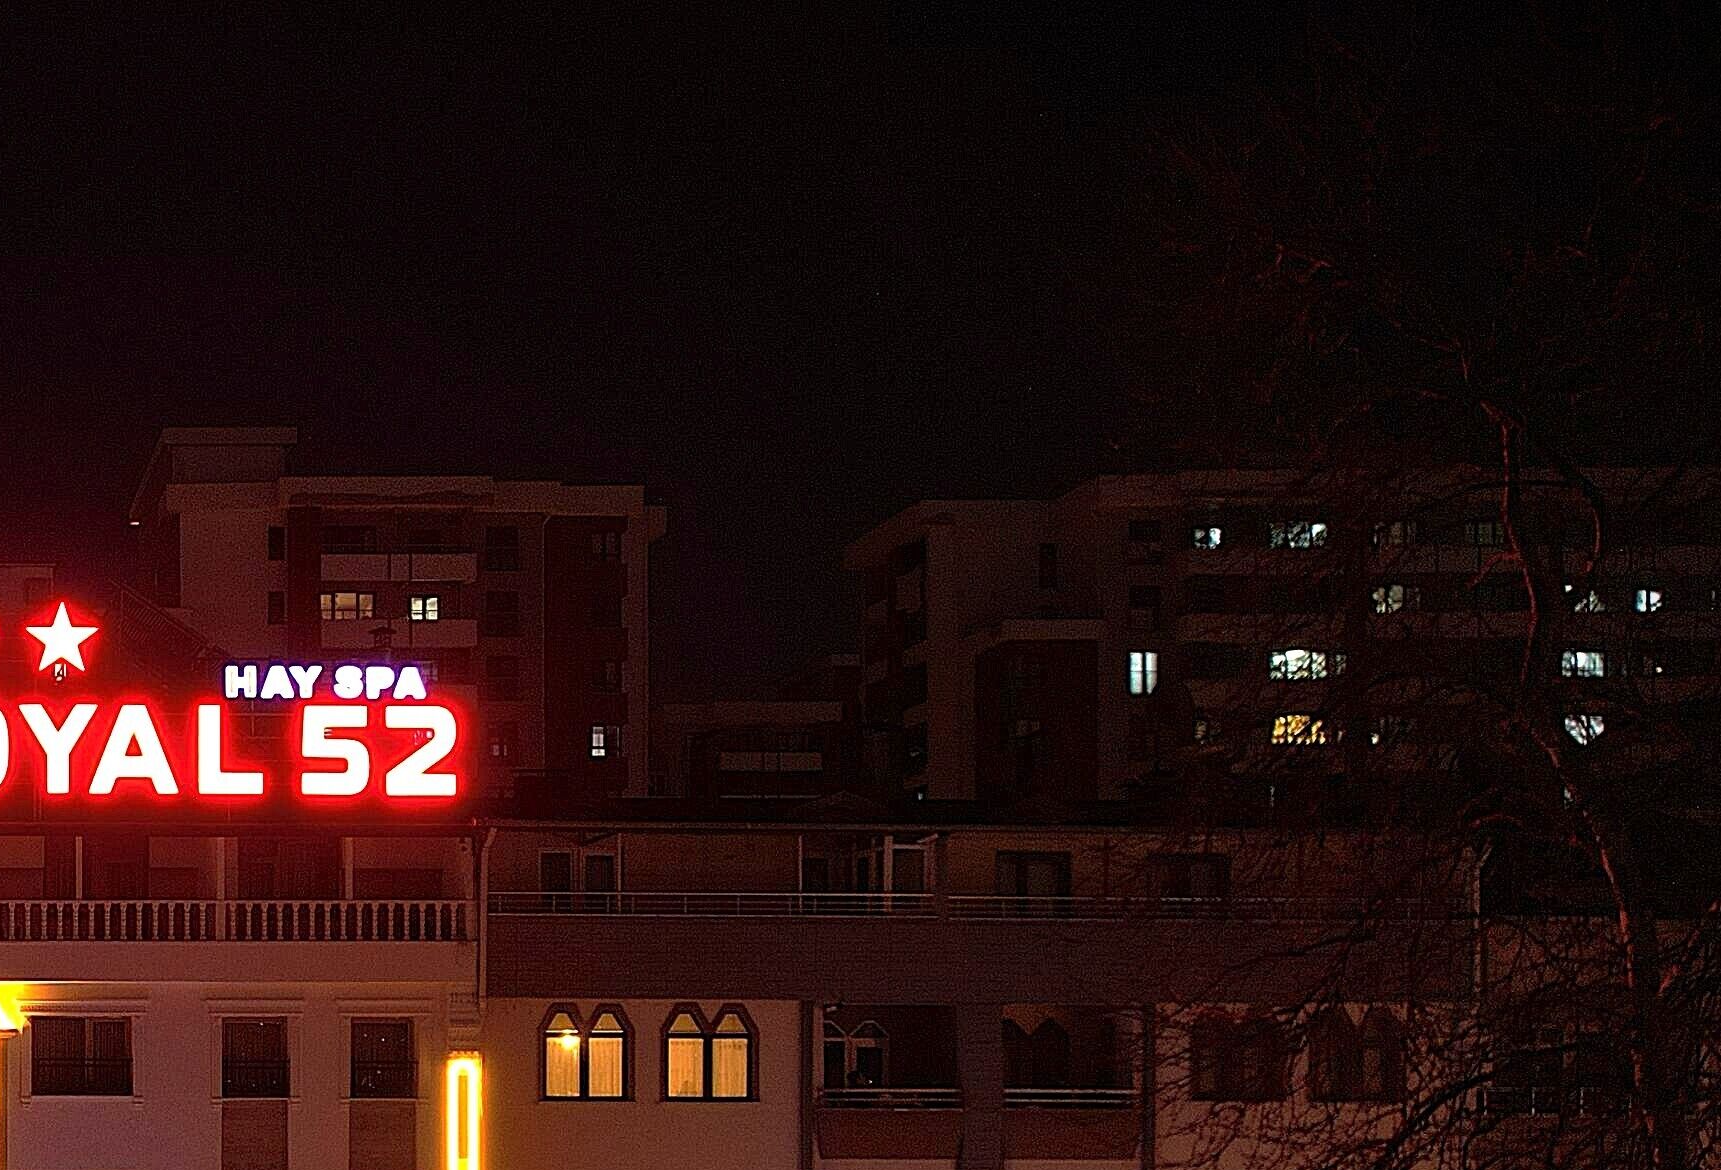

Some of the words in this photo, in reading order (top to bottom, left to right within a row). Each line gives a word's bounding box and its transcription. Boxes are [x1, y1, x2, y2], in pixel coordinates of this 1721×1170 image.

[226, 666, 322, 698] HAY
[334, 666, 426, 699] SPA
[302, 706, 456, 795] 52
